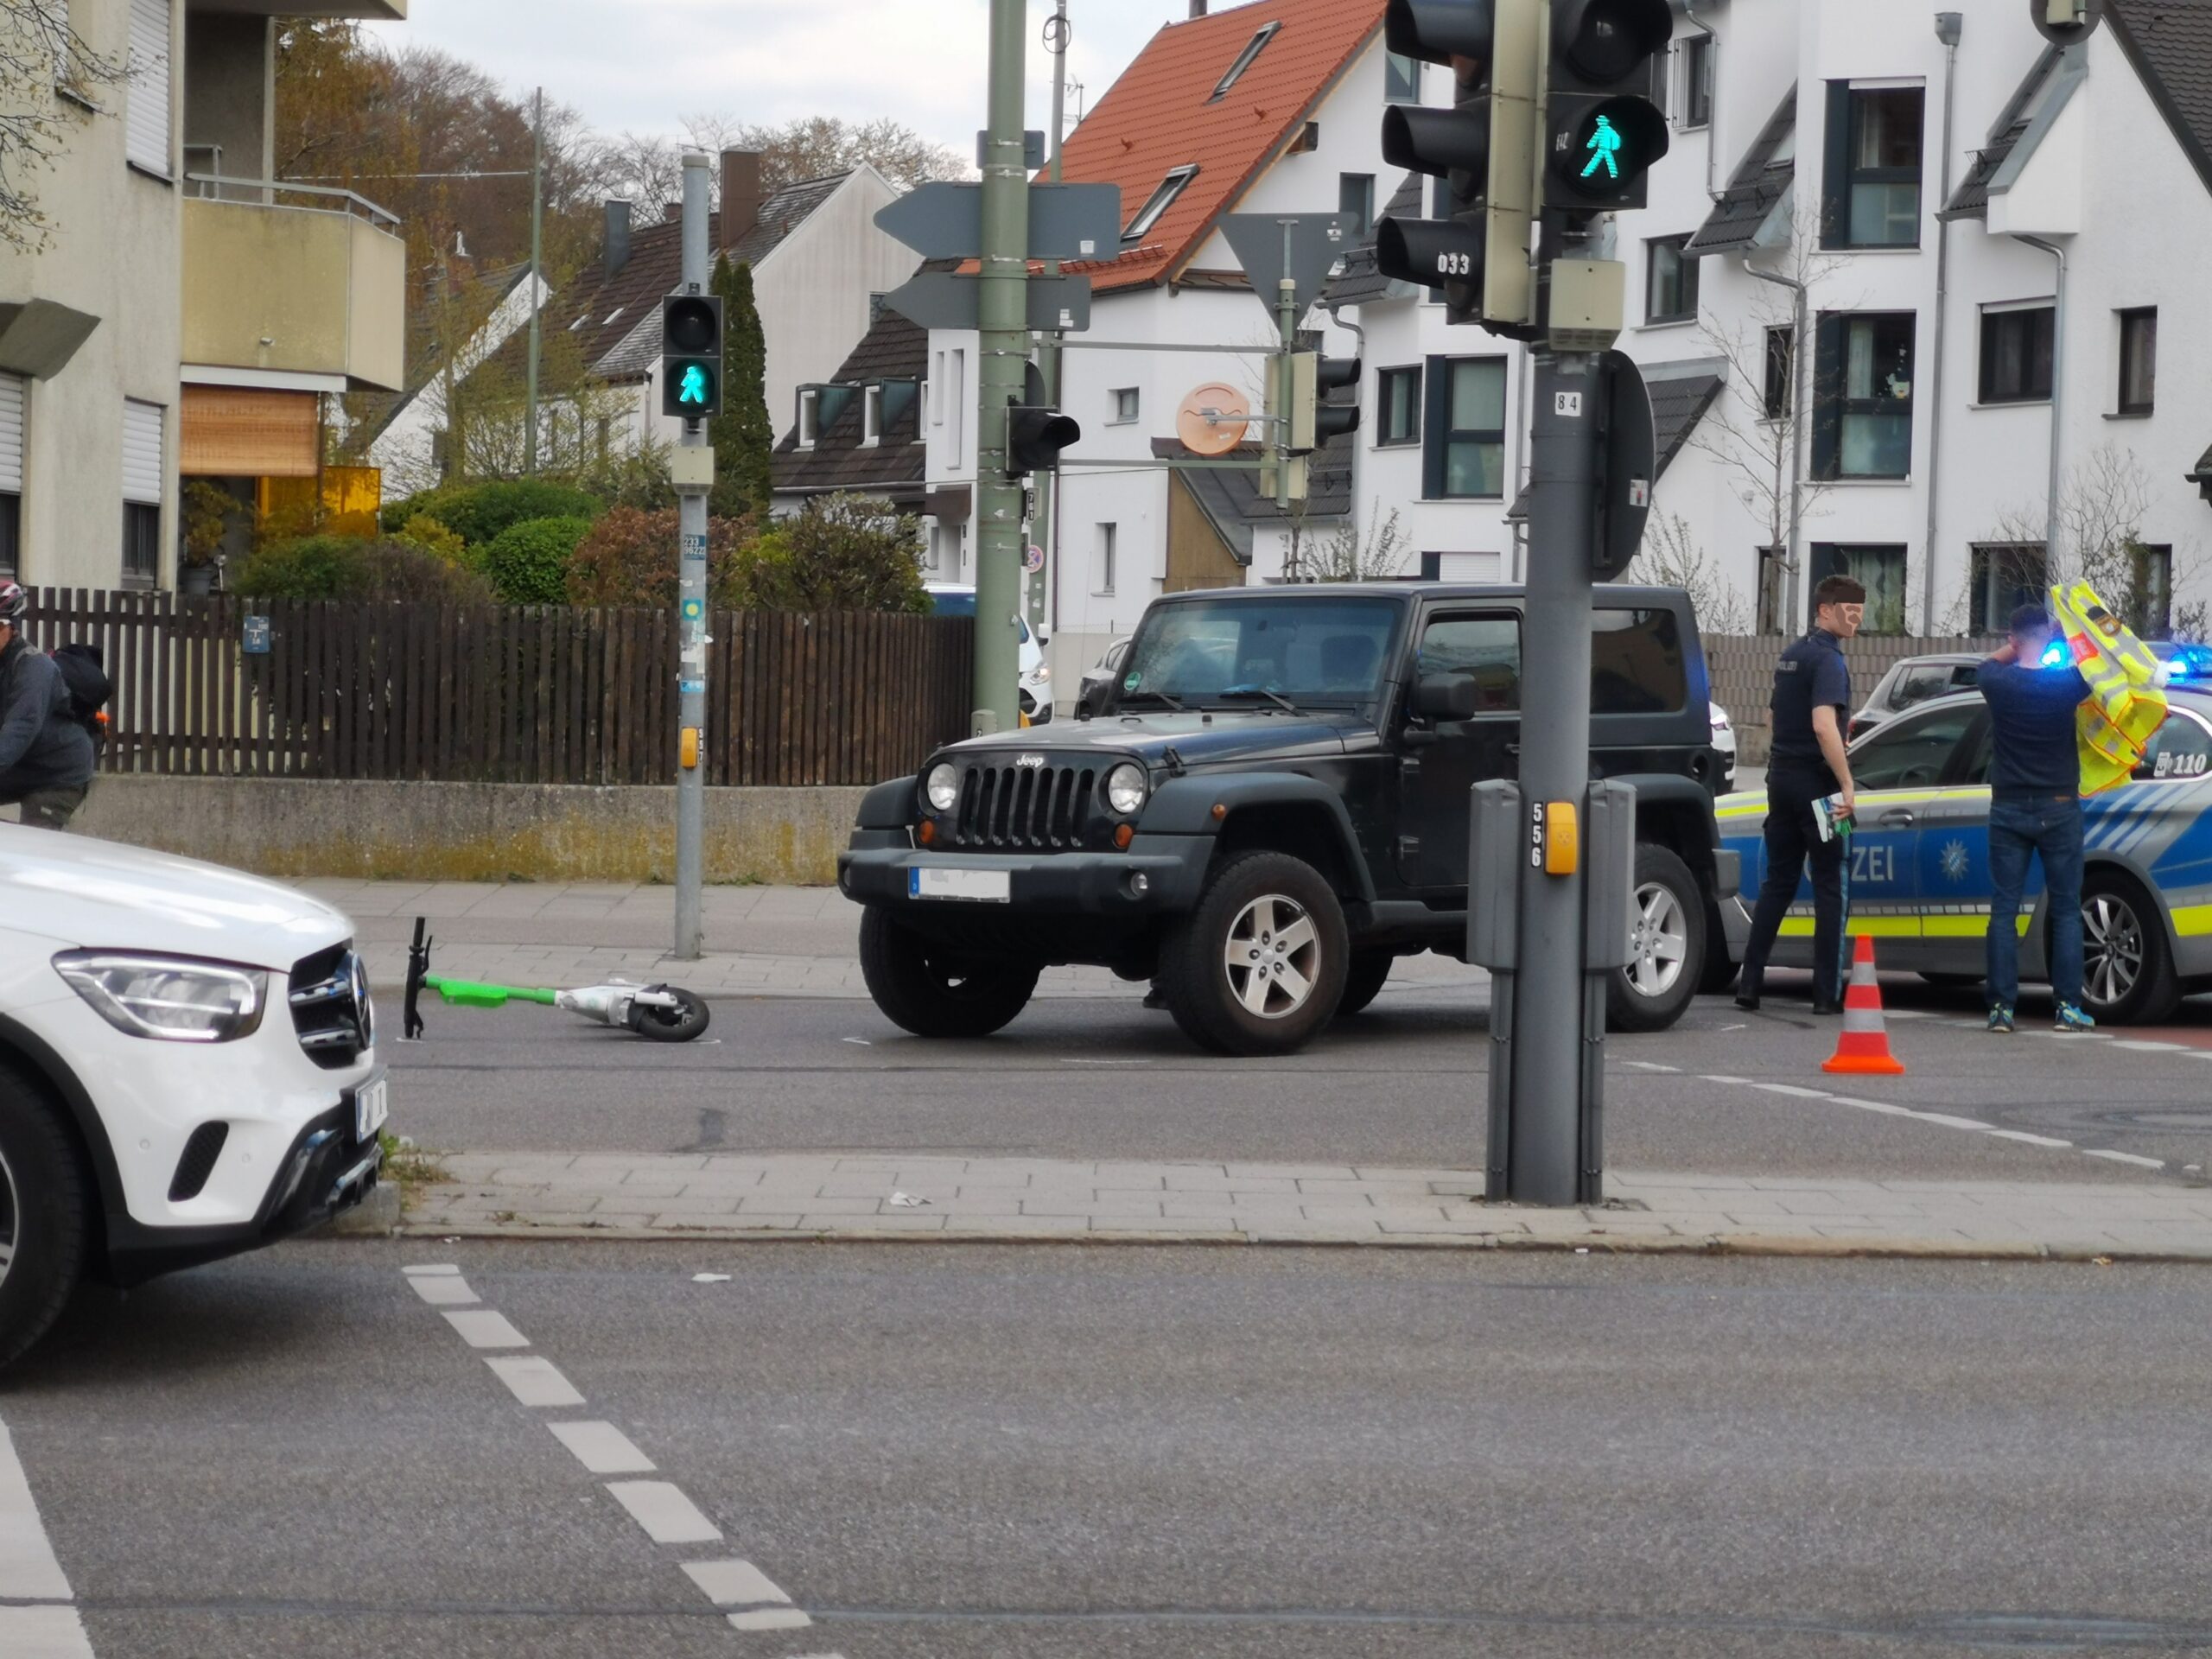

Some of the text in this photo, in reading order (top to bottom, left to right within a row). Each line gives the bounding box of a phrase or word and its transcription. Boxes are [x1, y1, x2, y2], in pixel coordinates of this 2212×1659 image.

[1438, 252, 1469, 275] 033
[683, 537, 699, 546] 233
[1016, 754, 1044, 768] Jeep
[2172, 753, 2207, 774] 110
[1531, 803, 1542, 867] 556
